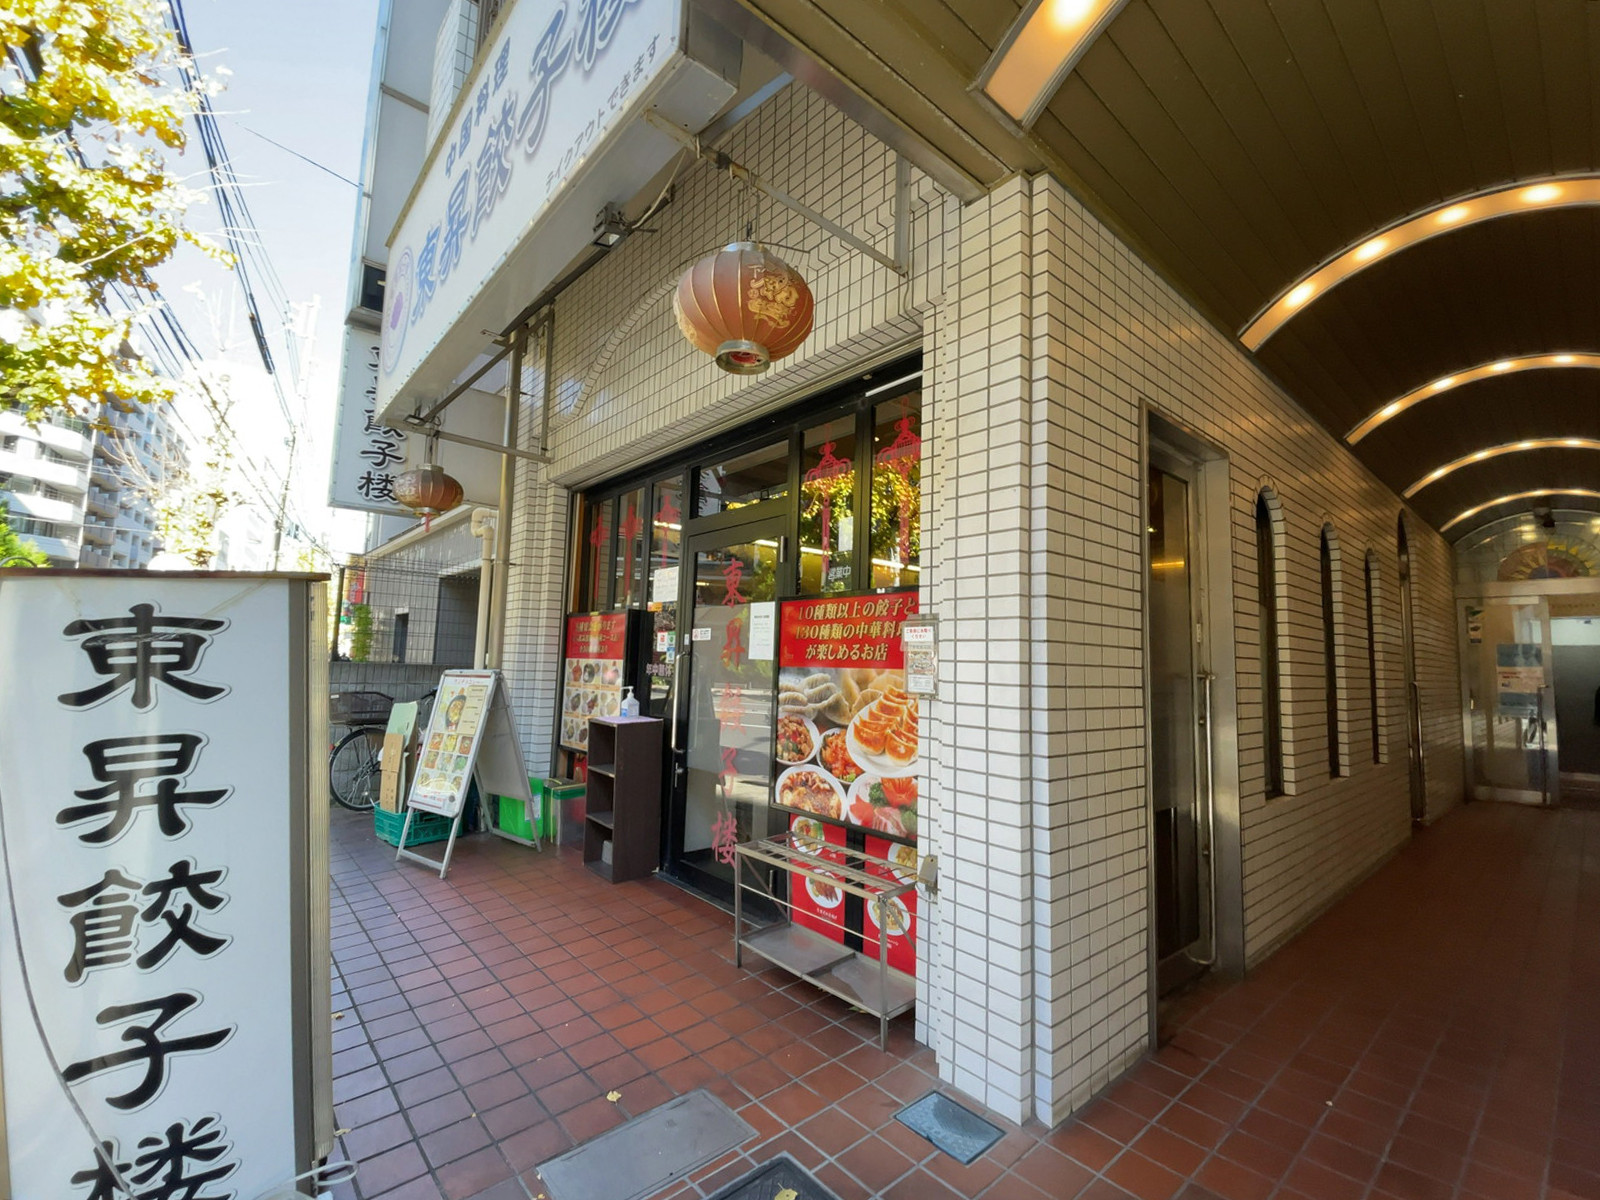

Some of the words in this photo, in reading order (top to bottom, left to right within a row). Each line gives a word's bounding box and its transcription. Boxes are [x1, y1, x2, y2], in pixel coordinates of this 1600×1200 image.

[445, 36, 511, 177] 中国料理
[545, 34, 660, 193] テイクアウトできます
[357, 346, 404, 501] 餃子楼
[798, 597, 916, 620] 10種類以上の餃子と
[805, 643, 888, 661] が楽しめるお店
